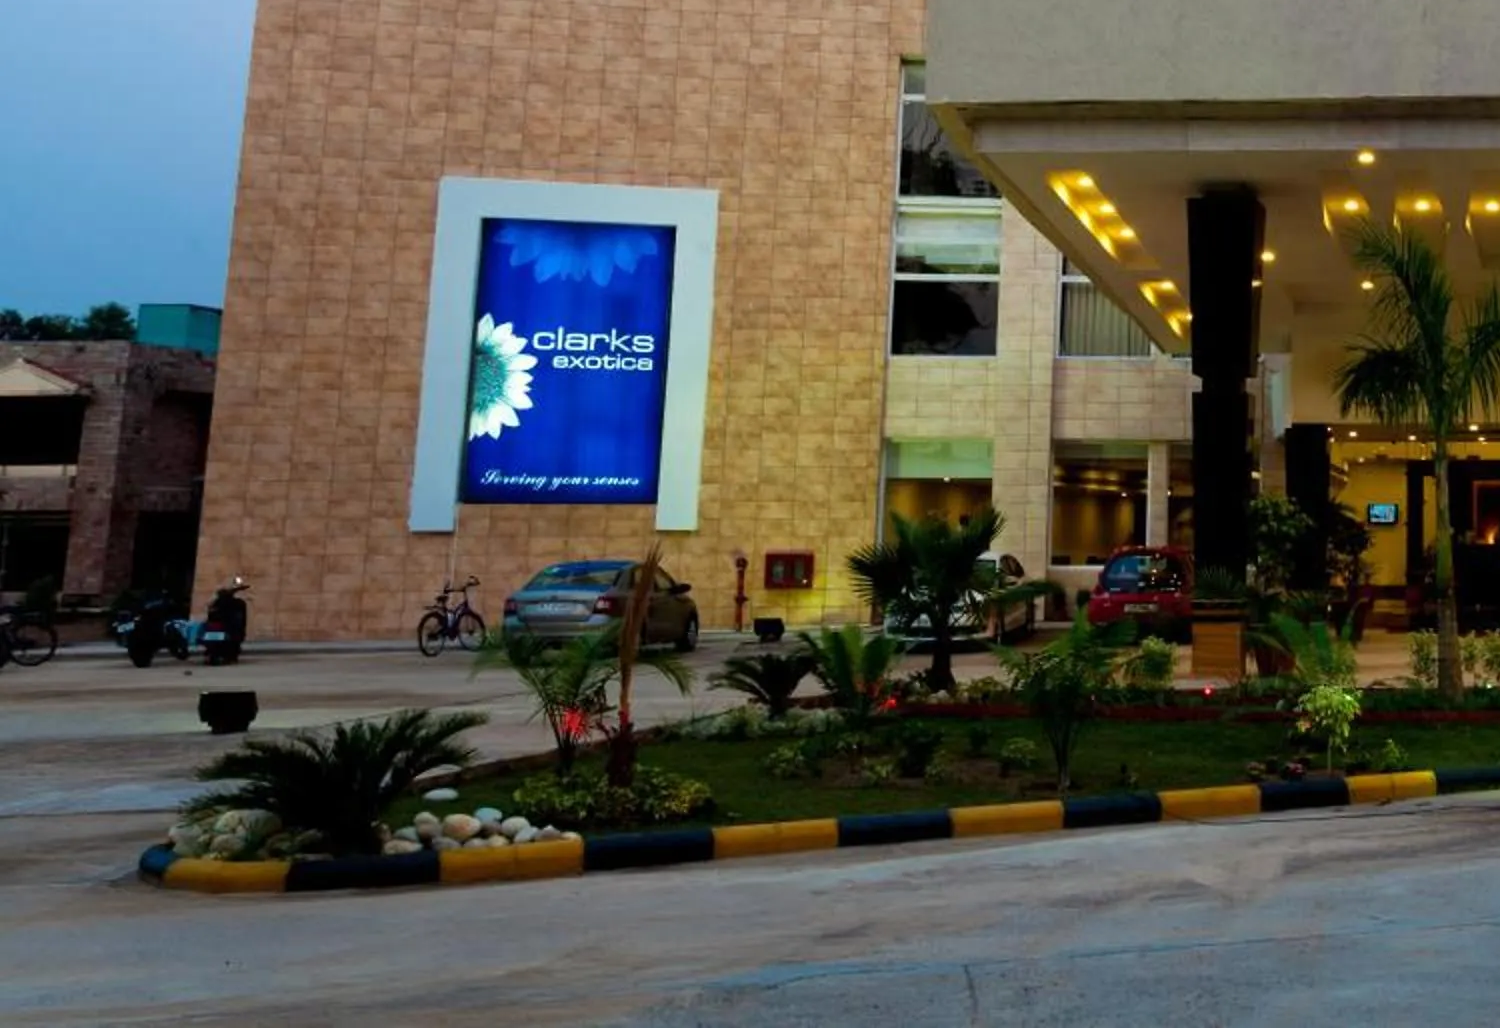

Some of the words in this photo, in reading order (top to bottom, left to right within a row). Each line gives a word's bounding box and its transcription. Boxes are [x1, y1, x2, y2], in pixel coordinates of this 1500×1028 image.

[532, 326, 655, 353] clarks
[552, 353, 653, 371] exotica
[549, 475, 589, 491] your
[592, 475, 640, 486] senses
